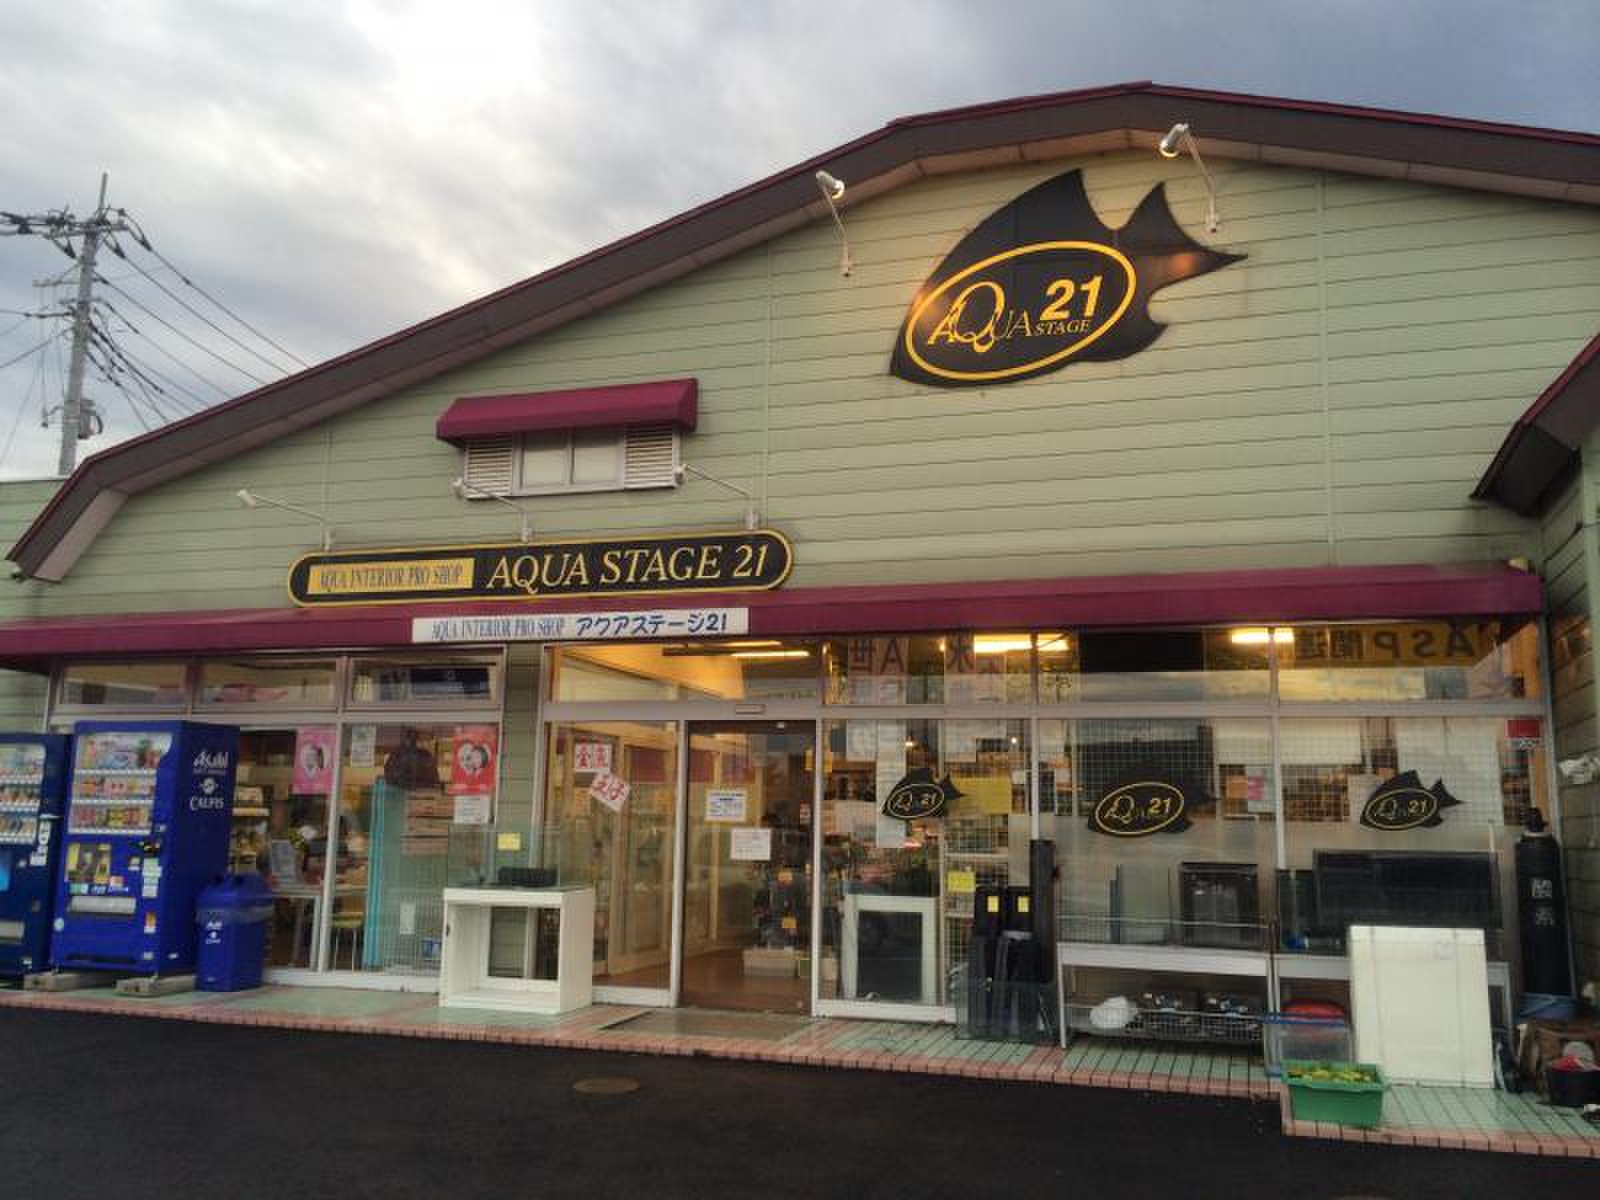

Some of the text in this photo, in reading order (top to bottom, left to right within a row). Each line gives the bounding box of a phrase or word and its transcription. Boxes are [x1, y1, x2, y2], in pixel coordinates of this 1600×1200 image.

[1039, 275, 1102, 320] 21
[928, 281, 1092, 353] AQUA STAGE
[321, 564, 463, 592] AQUA INTERIOR PRO SHOP
[486, 543, 769, 595] AQUA STAGE 21
[432, 611, 727, 640] AQUA INTERIOR PRO SHOP アクアステージ21
[1149, 797, 1172, 815] 21
